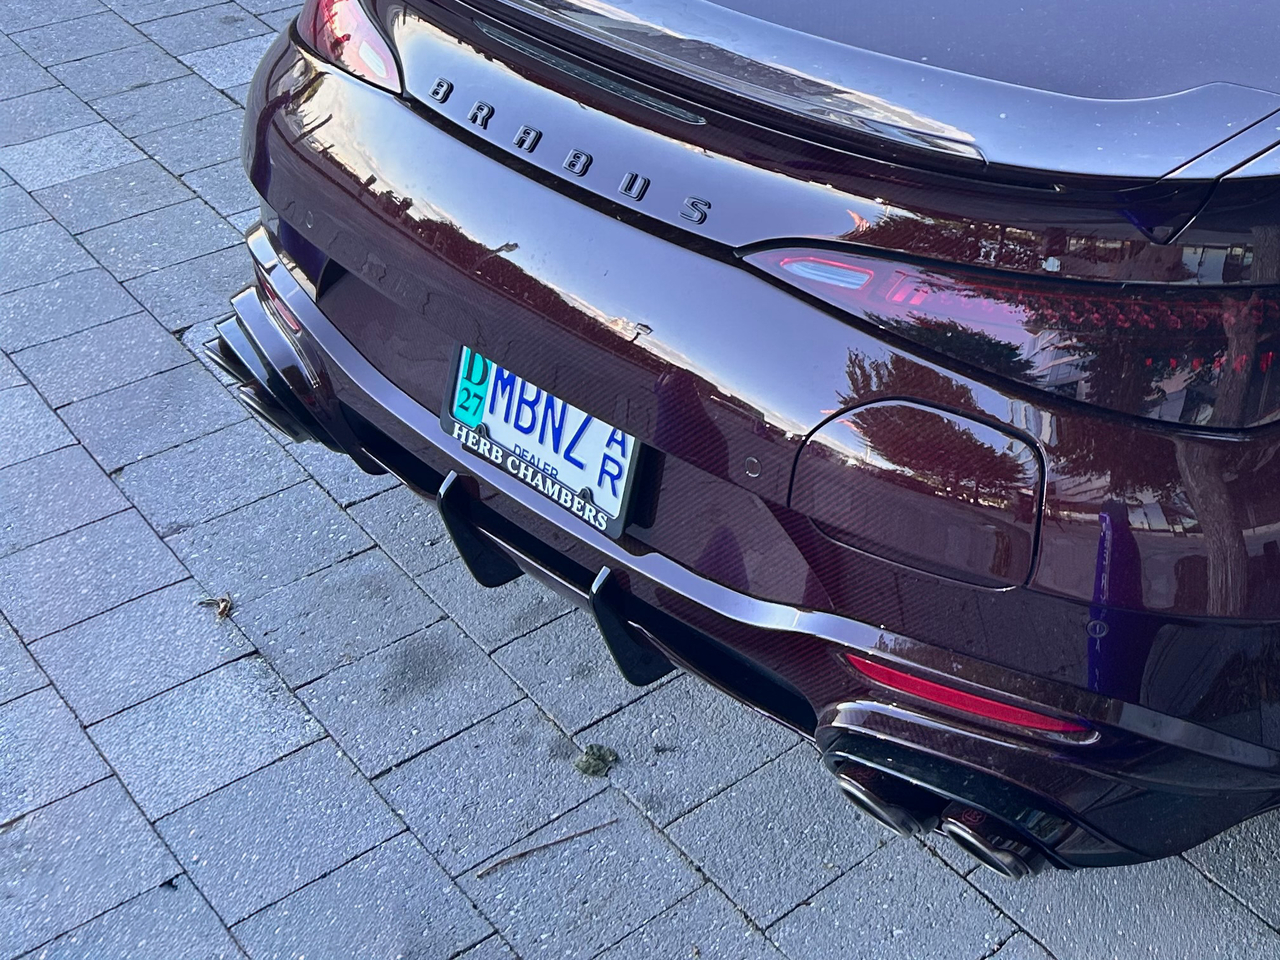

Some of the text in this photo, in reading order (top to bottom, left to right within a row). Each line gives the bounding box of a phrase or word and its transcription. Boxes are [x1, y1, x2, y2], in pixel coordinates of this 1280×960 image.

[428, 76, 712, 225] BRABUS
[458, 387, 483, 417] 27
[453, 422, 608, 531] HERB CHAMBERS
[511, 443, 559, 480] DEALER
[597, 453, 624, 498] R
